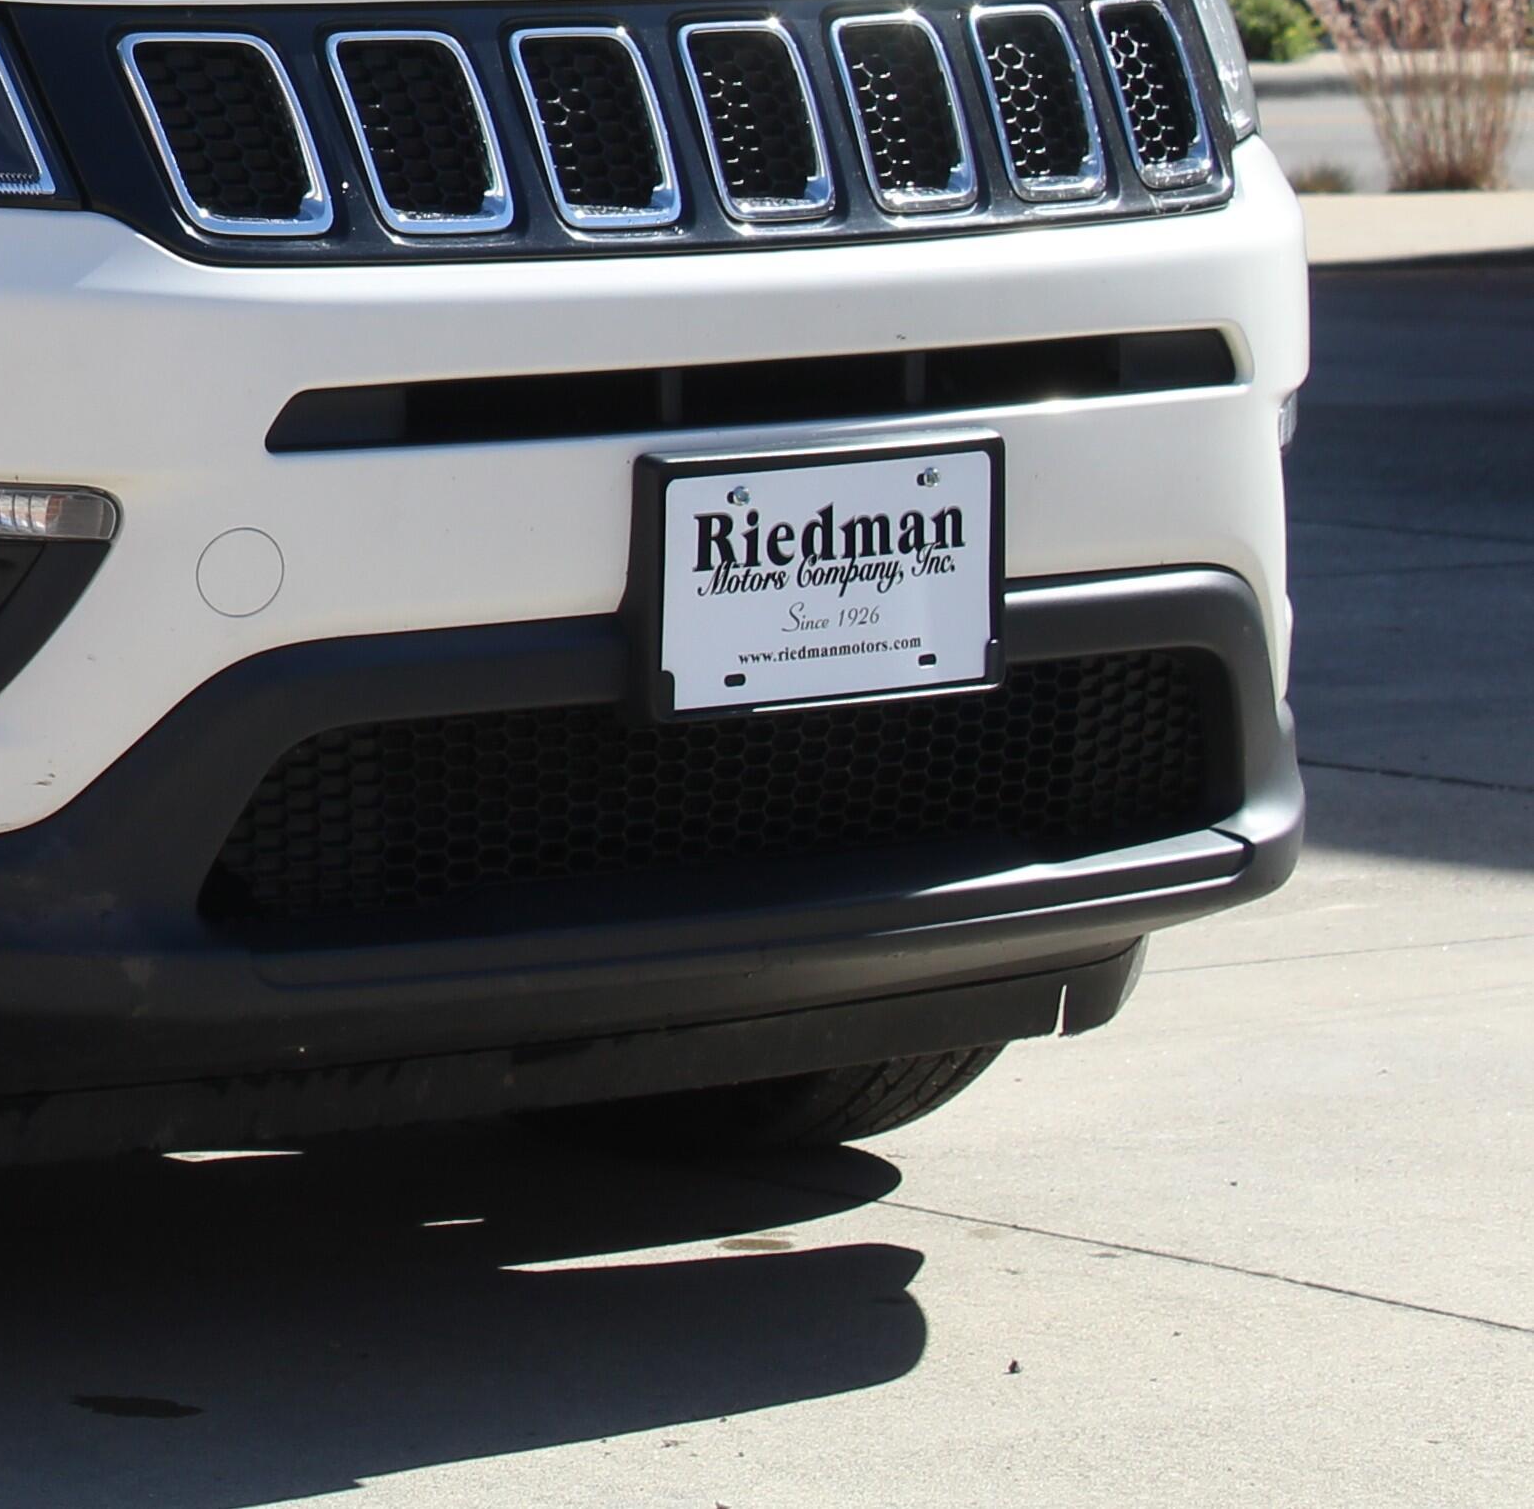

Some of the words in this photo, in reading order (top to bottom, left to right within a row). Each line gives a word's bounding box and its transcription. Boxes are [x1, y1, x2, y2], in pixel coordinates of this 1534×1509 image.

[692, 503, 966, 573] Riedman
[697, 558, 789, 597] Motors
[796, 554, 904, 597] Company,
[911, 541, 956, 576] Inc.
[782, 601, 830, 633] Since
[836, 605, 880, 629] 1926
[738, 634, 922, 665] www.riedmanmotors.com
